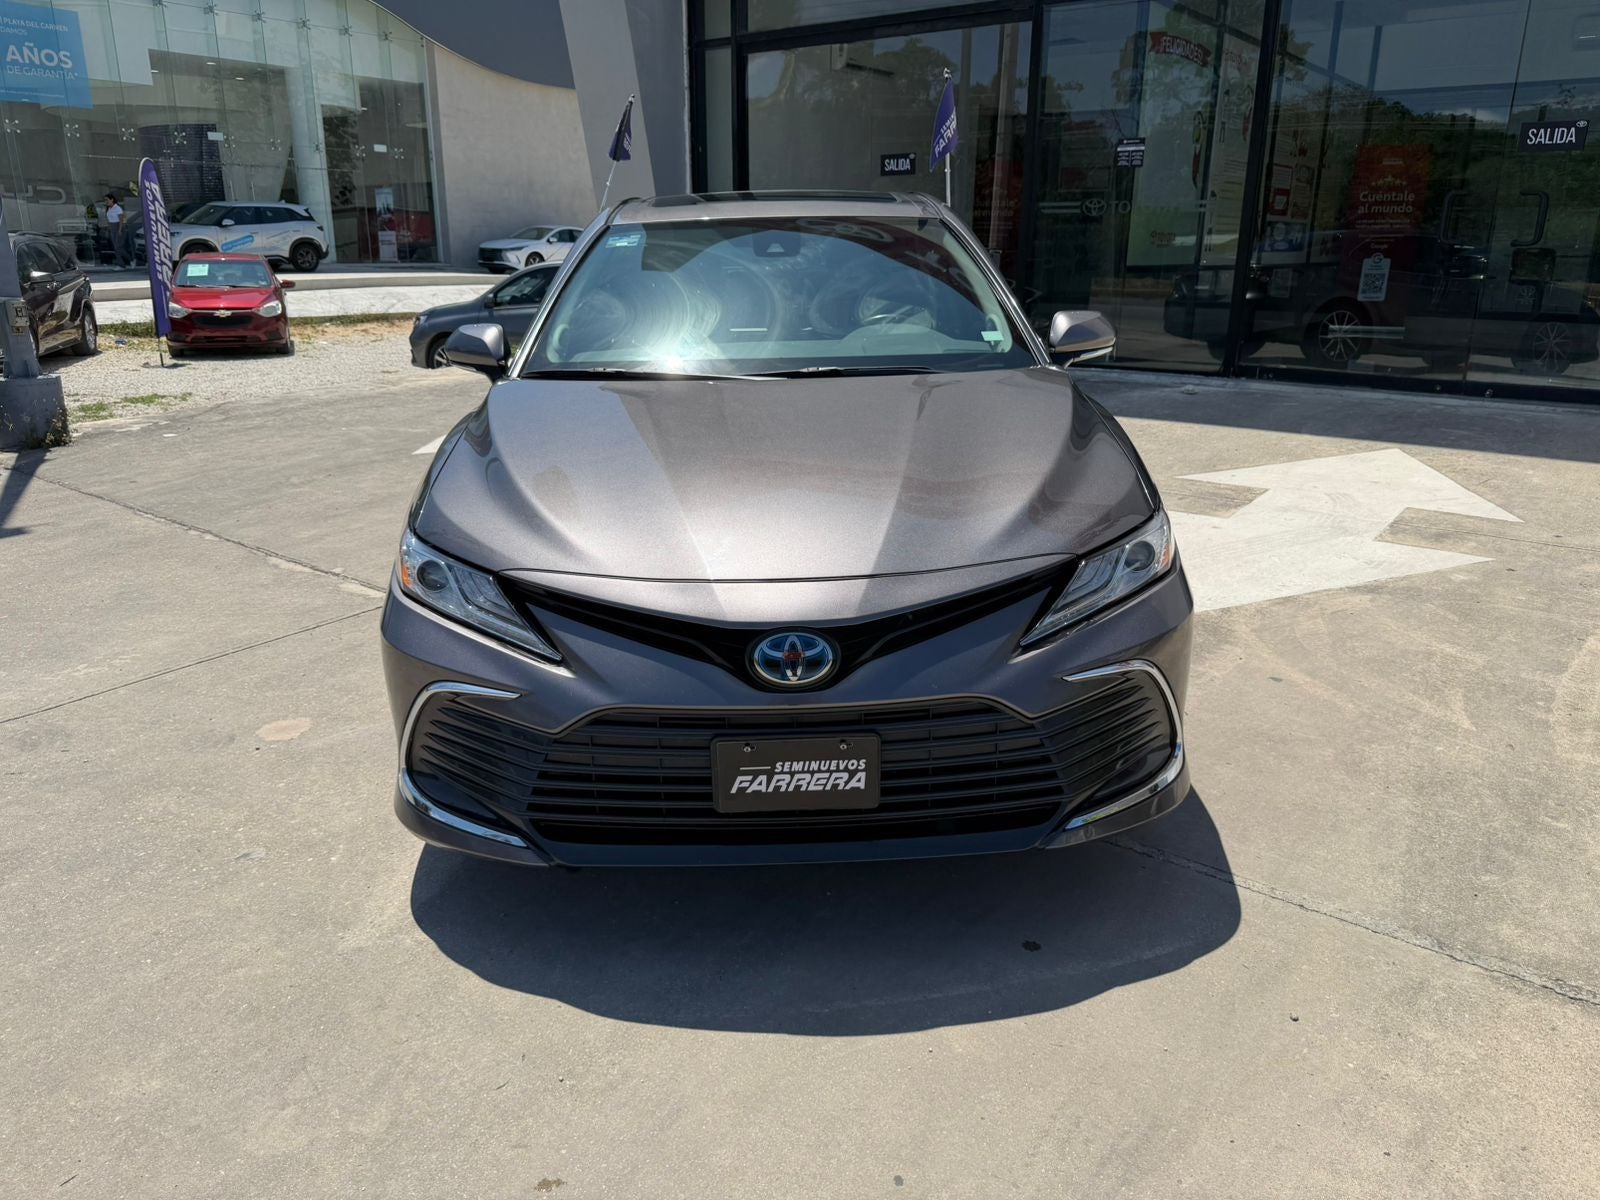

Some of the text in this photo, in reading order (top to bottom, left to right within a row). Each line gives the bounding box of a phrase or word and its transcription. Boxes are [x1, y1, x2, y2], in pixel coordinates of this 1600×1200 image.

[6, 42, 73, 69] AÑOS
[7, 65, 21, 75] DE
[1527, 127, 1576, 145] SALIDA
[884, 158, 911, 172] SALIDA
[1358, 203, 1413, 214] al mundo
[144, 179, 163, 282] SEMINUEVOS
[150, 181, 173, 297] RRERA
[774, 759, 866, 773] SEMINUEVOS
[730, 771, 866, 794] FARRERA
